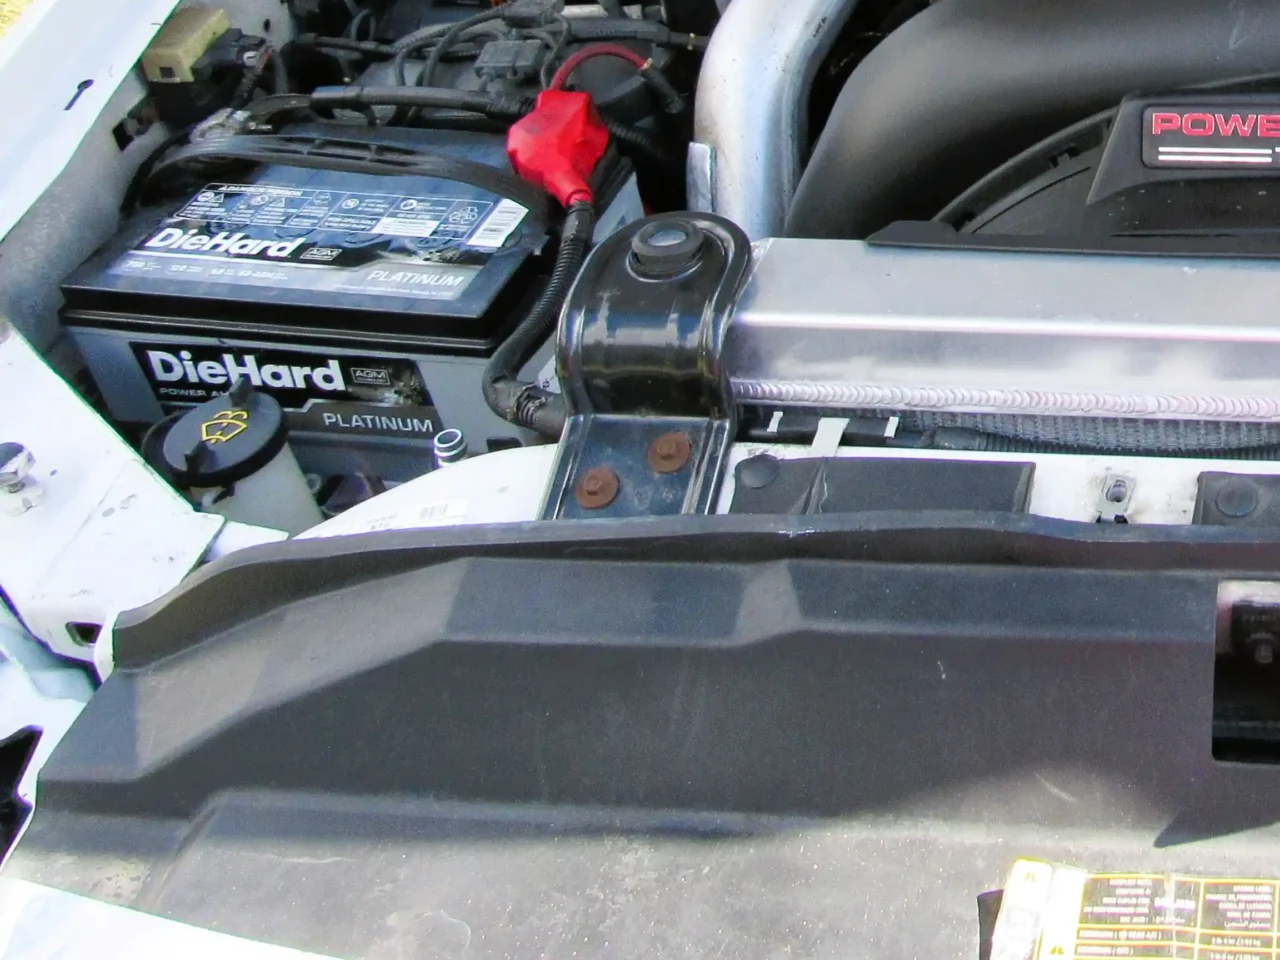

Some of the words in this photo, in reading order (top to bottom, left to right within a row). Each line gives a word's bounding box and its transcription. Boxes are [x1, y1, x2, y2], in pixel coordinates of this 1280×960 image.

[145, 228, 306, 258] DieHard
[367, 270, 465, 287] PLATINUM
[146, 350, 346, 391] DieHard
[355, 370, 386, 379] AGM
[159, 387, 207, 397] POWER
[323, 412, 433, 433] PLATINUM
